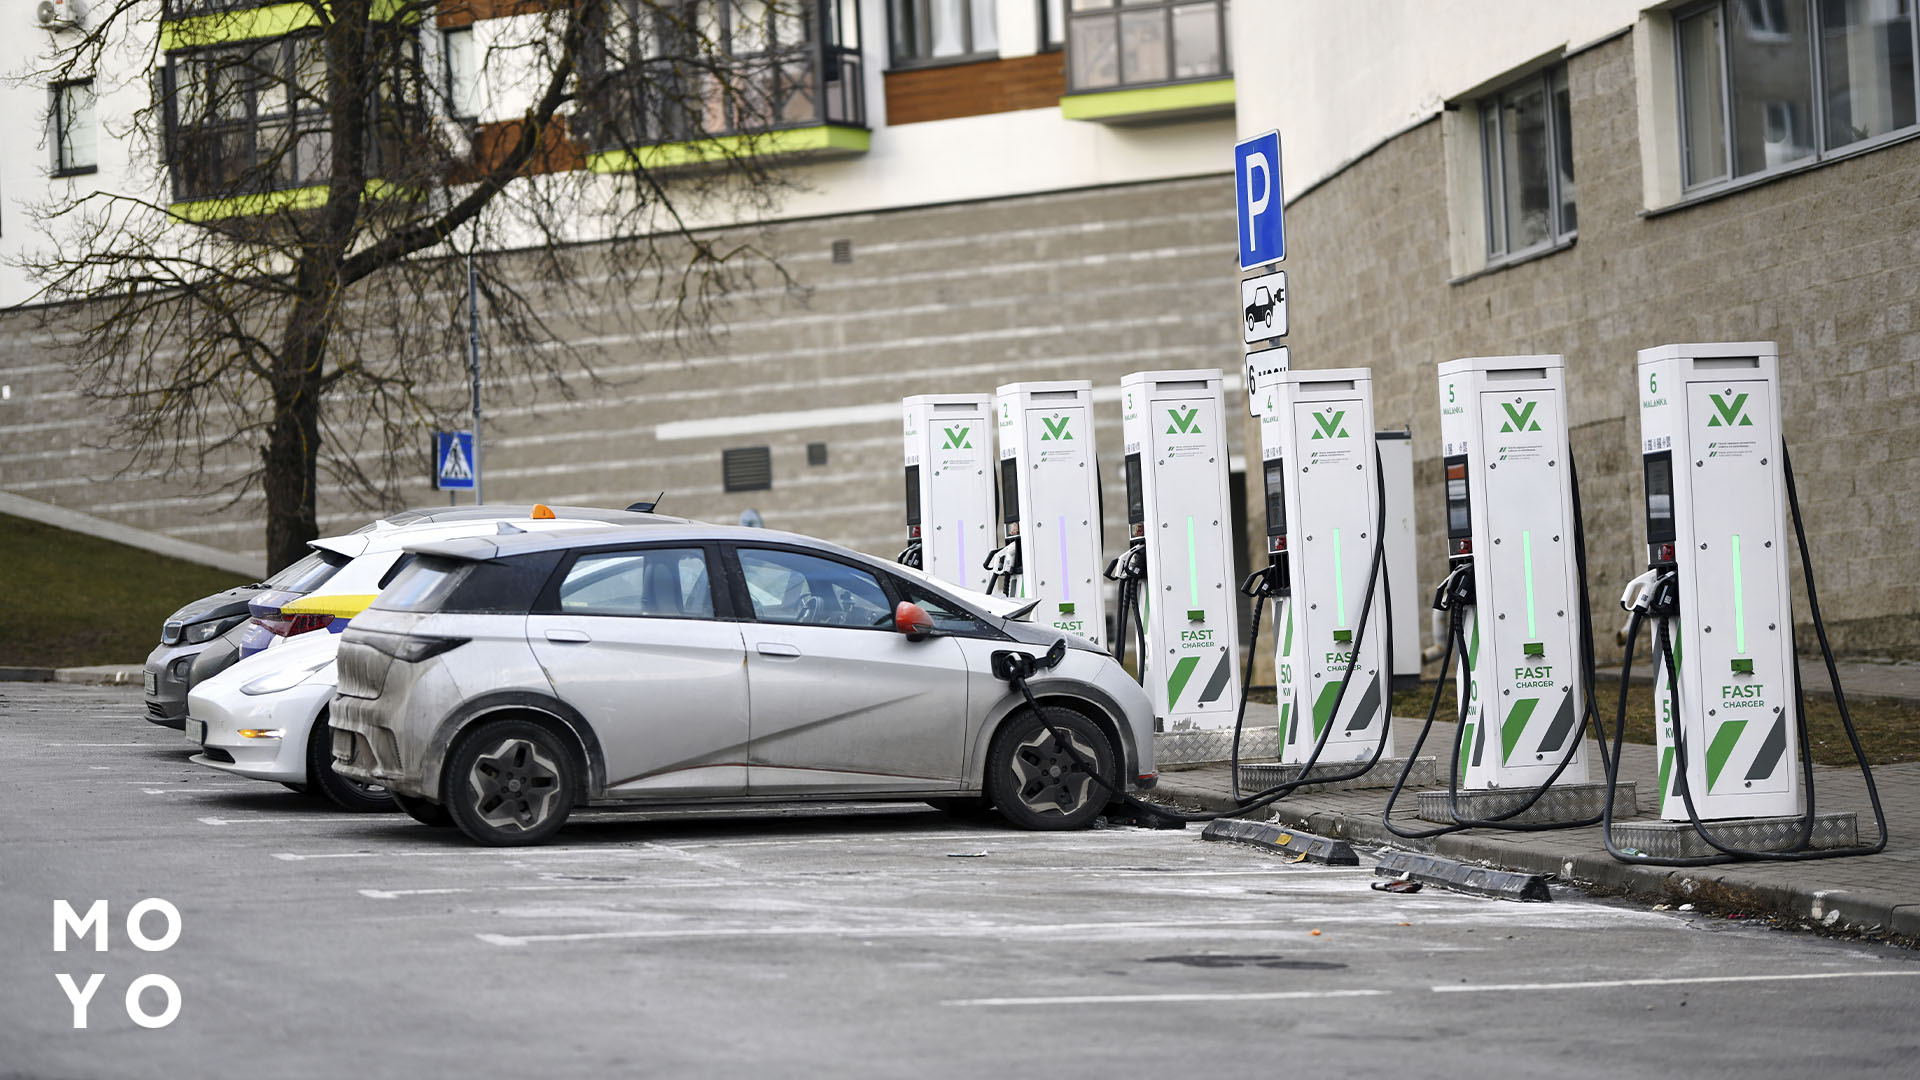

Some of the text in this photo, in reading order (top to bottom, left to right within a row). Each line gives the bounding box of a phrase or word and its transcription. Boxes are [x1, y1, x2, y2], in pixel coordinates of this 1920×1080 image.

[1246, 152, 1271, 251] P
[1249, 365, 1256, 395] 6
[1650, 373, 1657, 393] 6
[1128, 393, 1133, 410] 3
[1449, 384, 1455, 403] 5
[1004, 403, 1008, 418] 2
[1267, 395, 1273, 412] 4
[1181, 630, 1213, 641] FAST
[1281, 664, 1292, 684] 50
[1515, 667, 1552, 679] FAST
[1516, 681, 1554, 689] CHARGER
[1722, 685, 1763, 698] FAST
[1723, 701, 1765, 709] CHARGER
